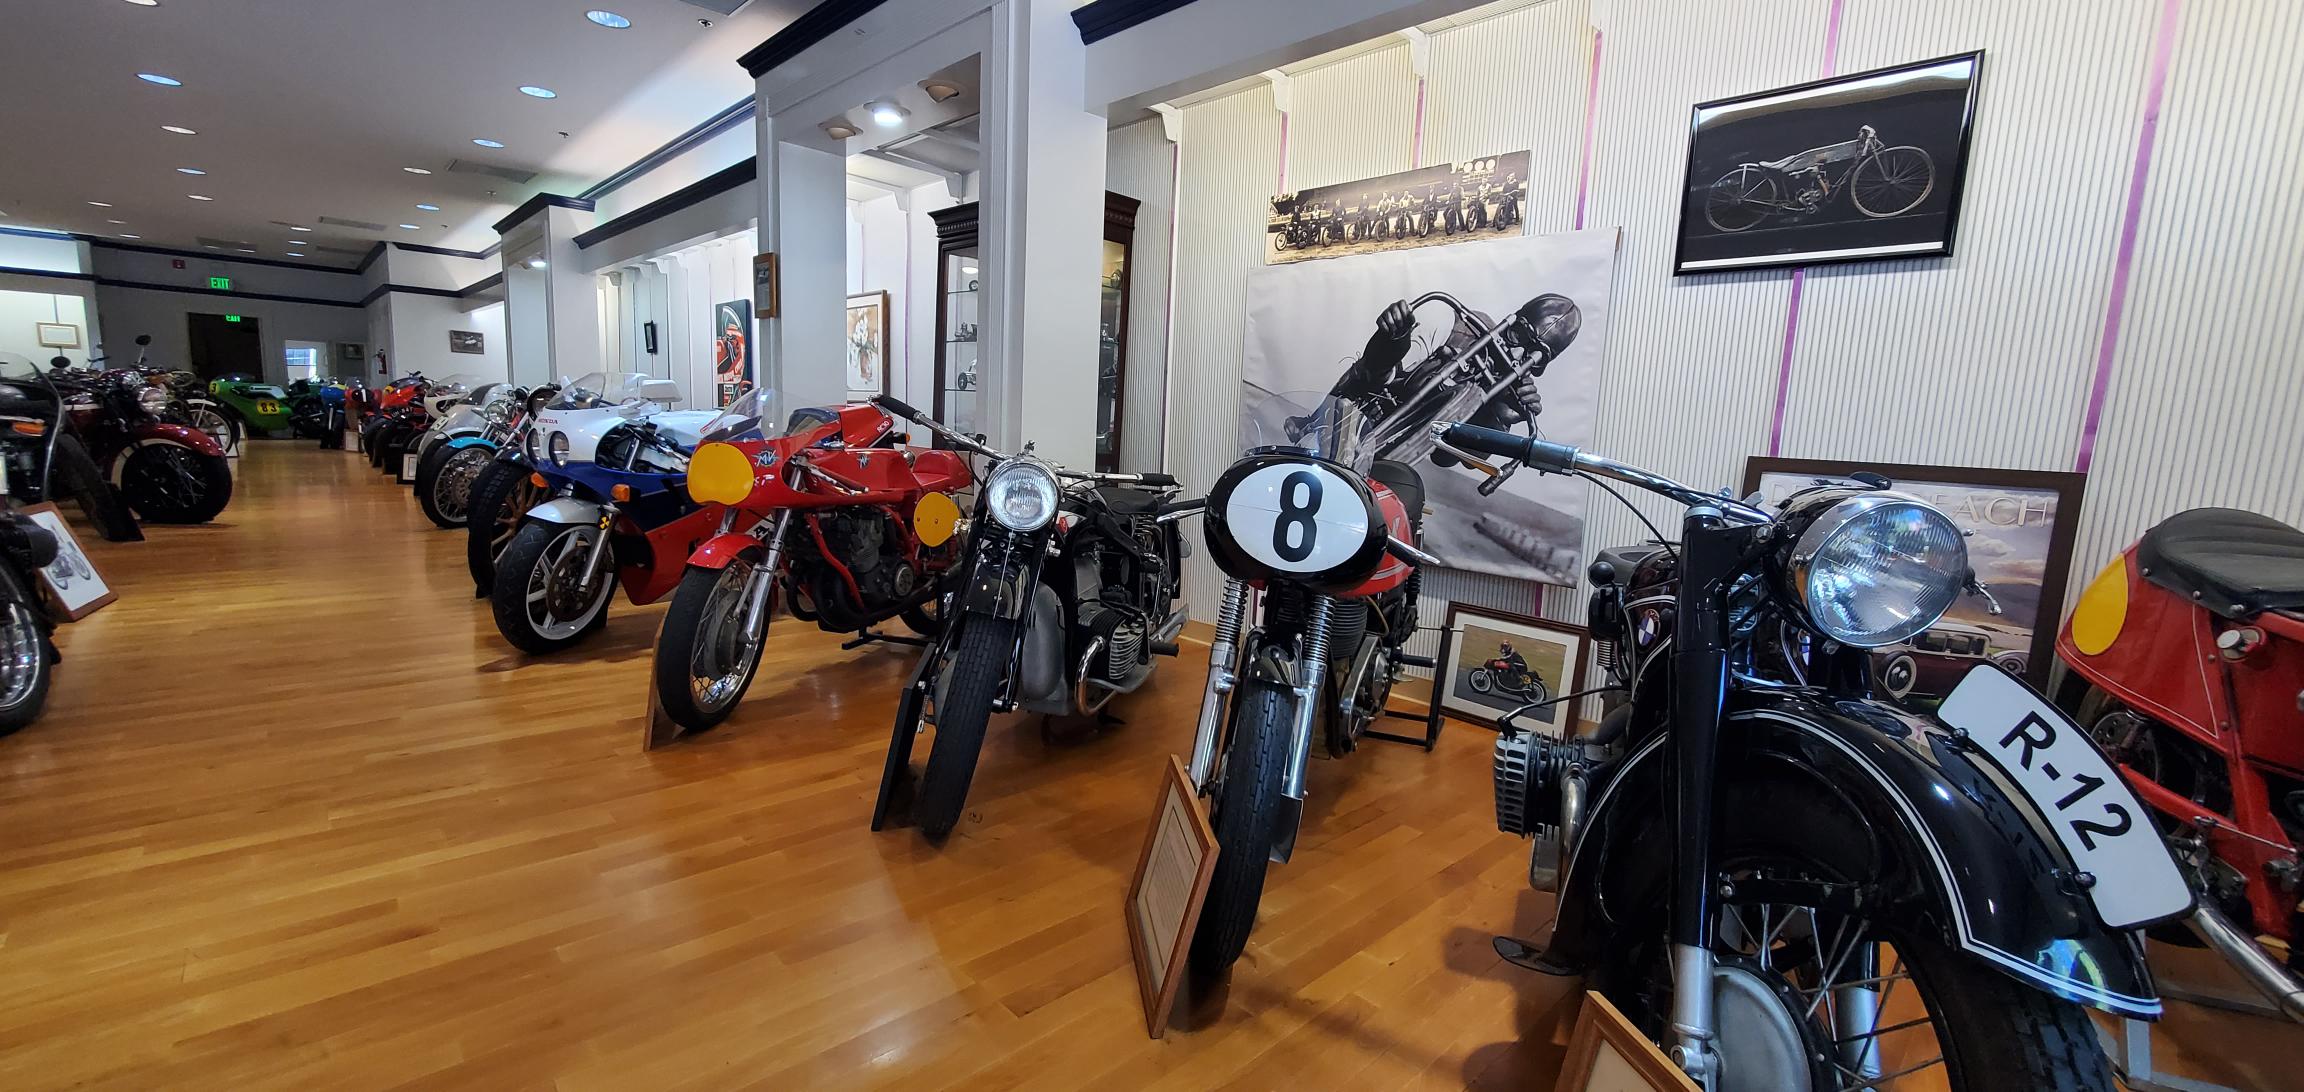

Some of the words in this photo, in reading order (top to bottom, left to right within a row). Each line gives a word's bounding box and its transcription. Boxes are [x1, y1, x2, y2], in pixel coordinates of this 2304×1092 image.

[211, 277, 230, 289] EXIT
[1272, 470, 1324, 563] 8
[1998, 710, 2132, 852] R-12
